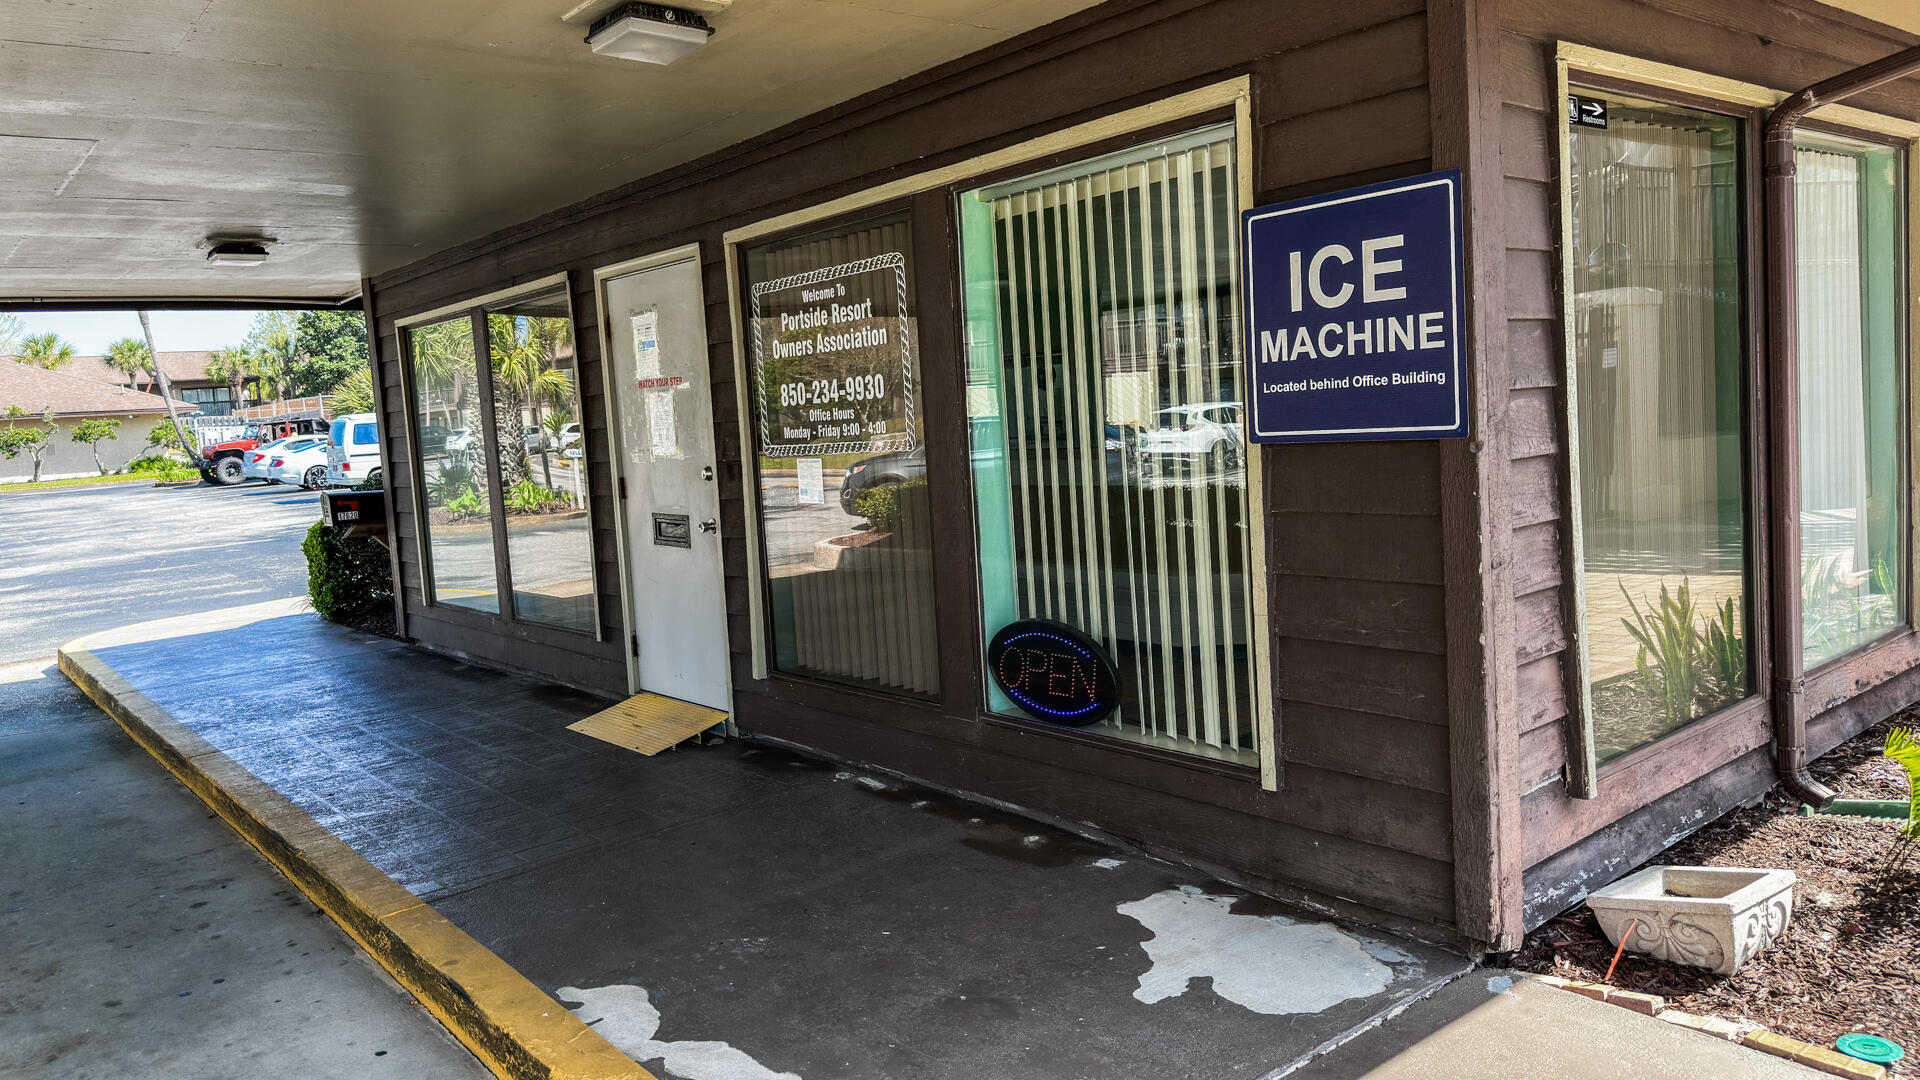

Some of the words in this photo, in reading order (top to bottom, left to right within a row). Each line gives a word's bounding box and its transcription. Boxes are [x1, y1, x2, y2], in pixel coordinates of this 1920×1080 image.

[1582, 114, 1606, 126] Restrooms
[1289, 234, 1407, 312] ICE
[802, 287, 835, 303] Welcome
[836, 284, 846, 297] To
[780, 306, 828, 332] Portside
[831, 298, 872, 324] Resort
[772, 339, 813, 360] Owners
[816, 326, 888, 354] Association
[1260, 311, 1446, 364] MACHINE
[638, 379, 654, 388] WATCH
[655, 378, 668, 388] YOUR
[670, 376, 682, 386] STEP
[780, 374, 884, 406] 850-234-9930
[1263, 375, 1307, 394] Located
[1310, 376, 1350, 390] behind
[1352, 372, 1388, 387] Office
[1392, 371, 1446, 386] Building
[810, 408, 831, 422] Office
[832, 408, 854, 420] Hours
[784, 426, 810, 440] Monday
[818, 424, 840, 439] Friday
[842, 422, 860, 436] 9:00
[868, 420, 886, 434] 4:00
[1000, 646, 1096, 702] OPEN
